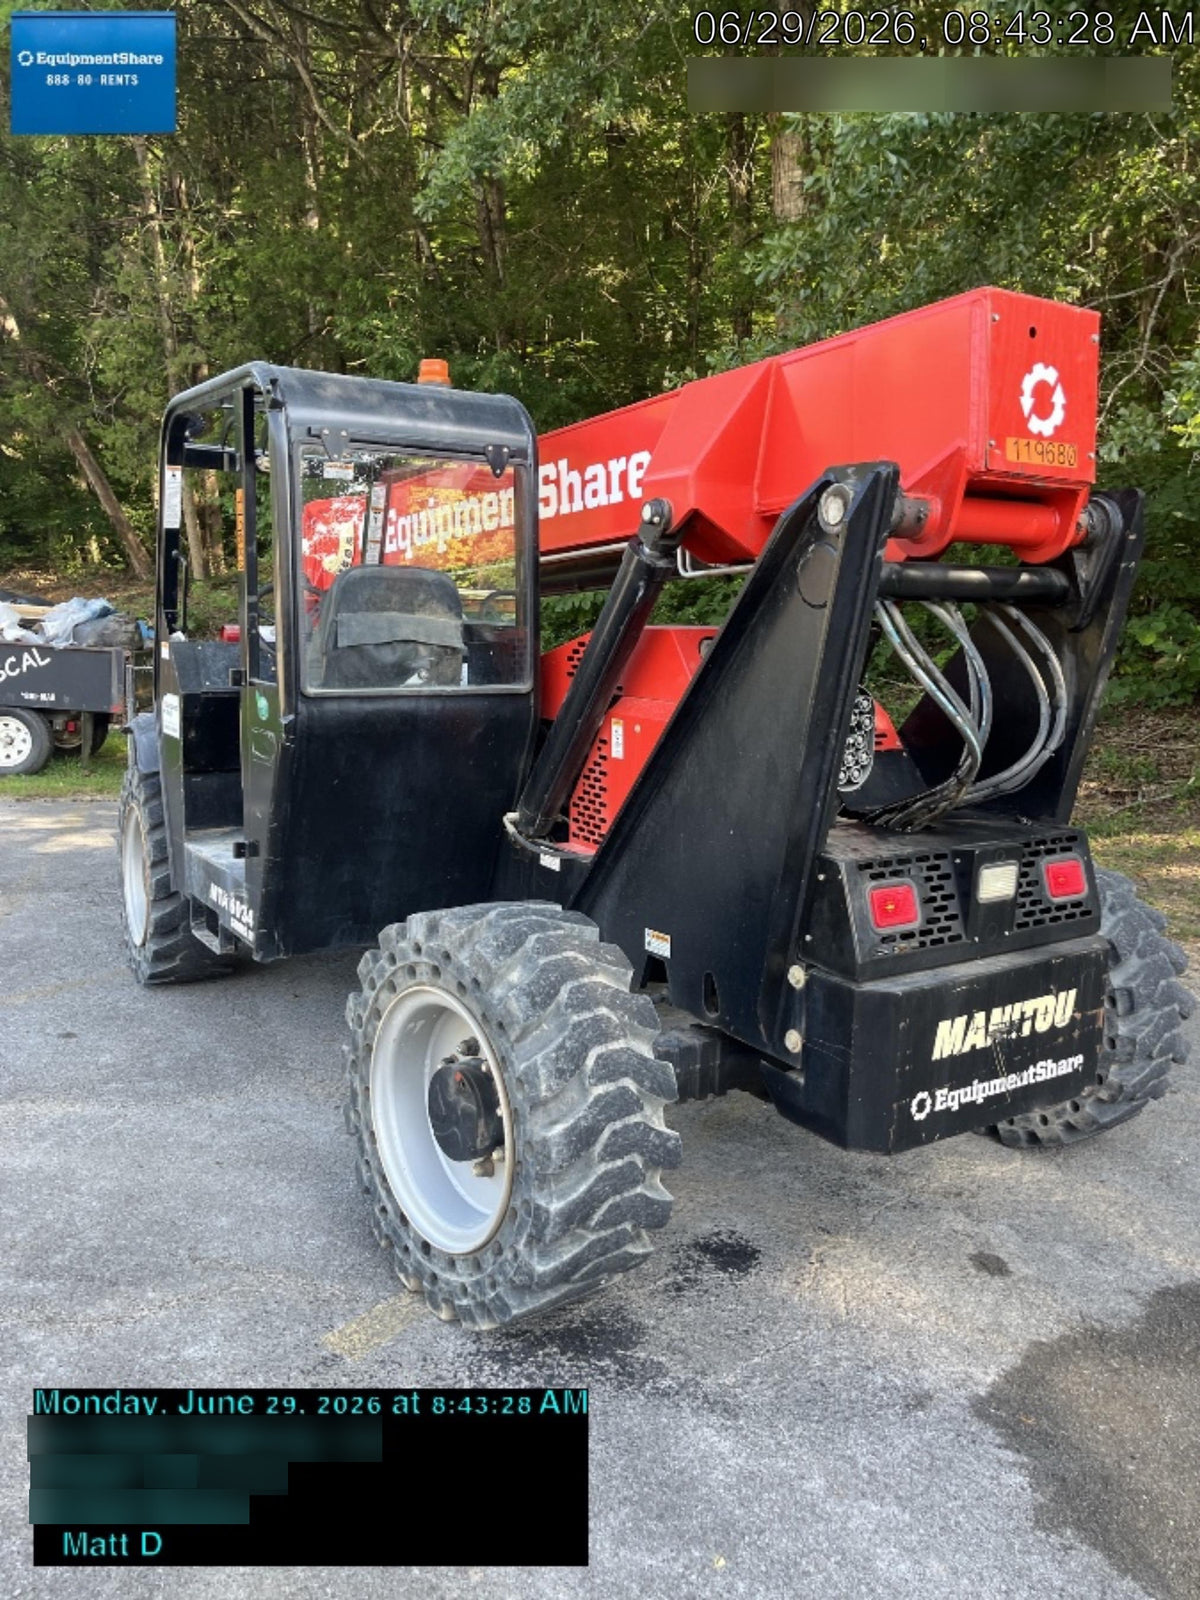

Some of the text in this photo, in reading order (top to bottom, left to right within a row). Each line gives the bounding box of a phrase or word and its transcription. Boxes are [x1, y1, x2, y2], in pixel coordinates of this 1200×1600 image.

[1013, 440, 1077, 467] 119680
[931, 988, 1078, 1062] MANITOU
[933, 1054, 1085, 1112] EquipmentShare
